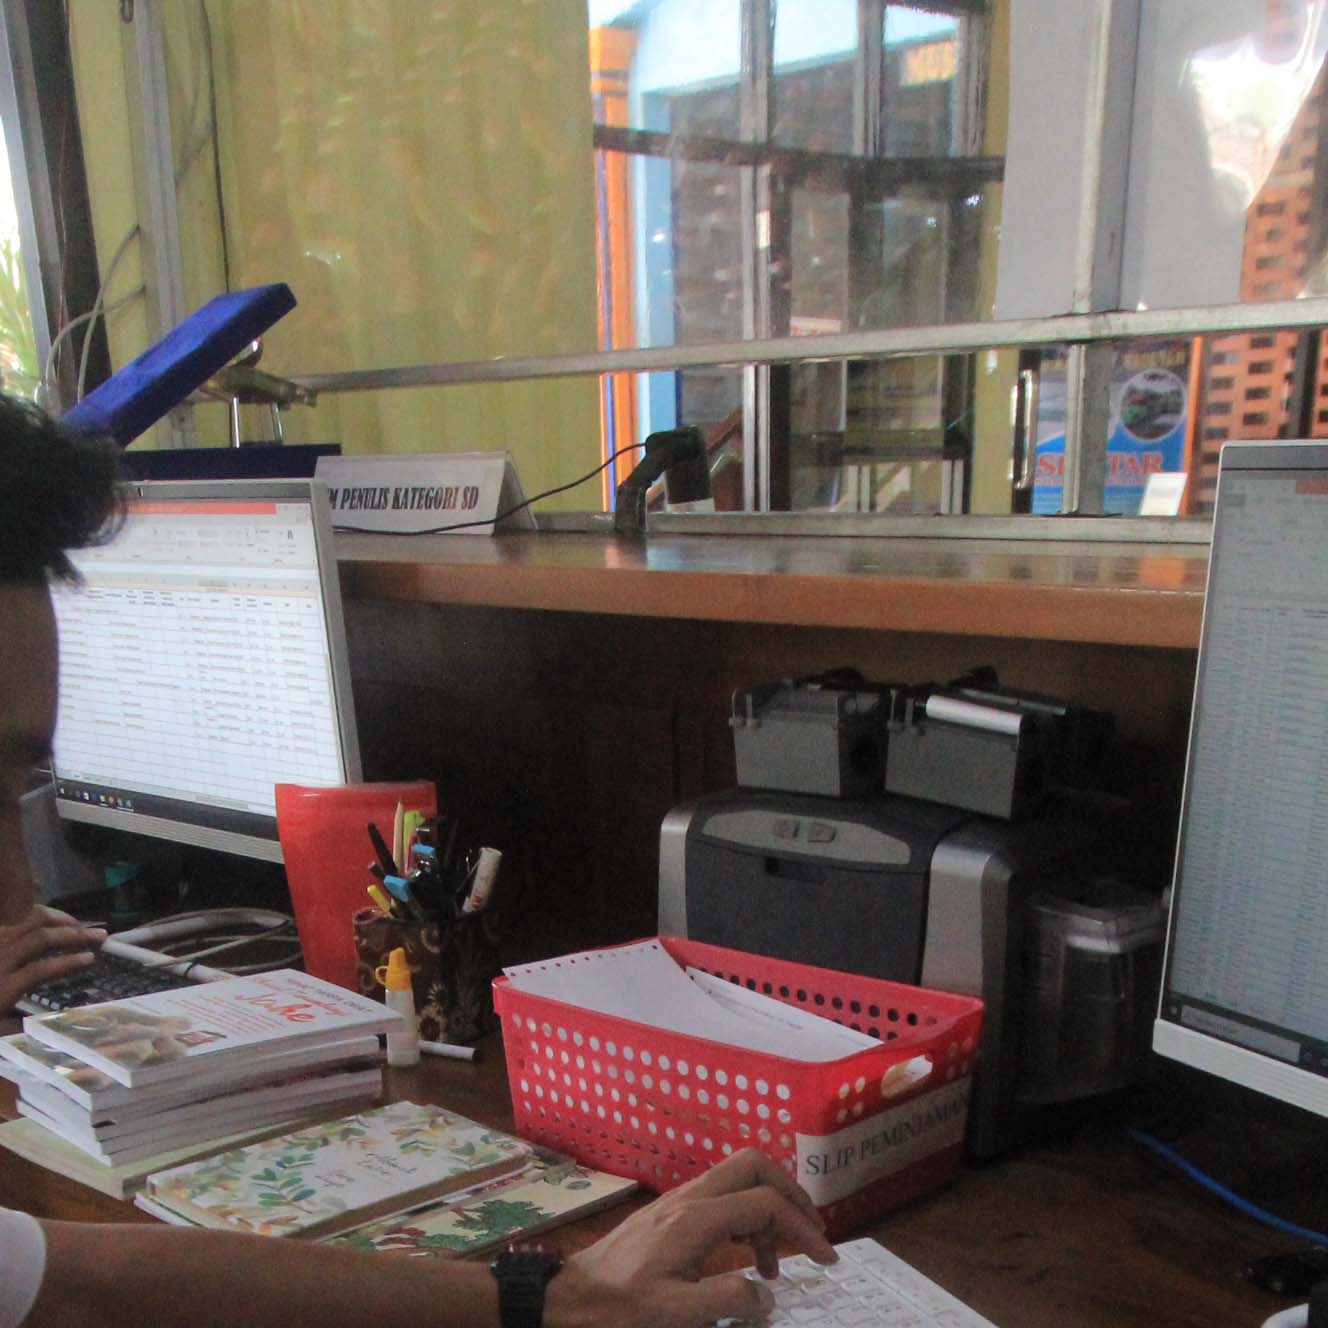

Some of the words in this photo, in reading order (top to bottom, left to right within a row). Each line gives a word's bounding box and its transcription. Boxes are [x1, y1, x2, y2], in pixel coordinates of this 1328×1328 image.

[340, 486, 391, 511] PENULIS
[392, 486, 460, 511] KATEGORI
[461, 485, 480, 511] SD
[805, 1143, 855, 1176] SLIP
